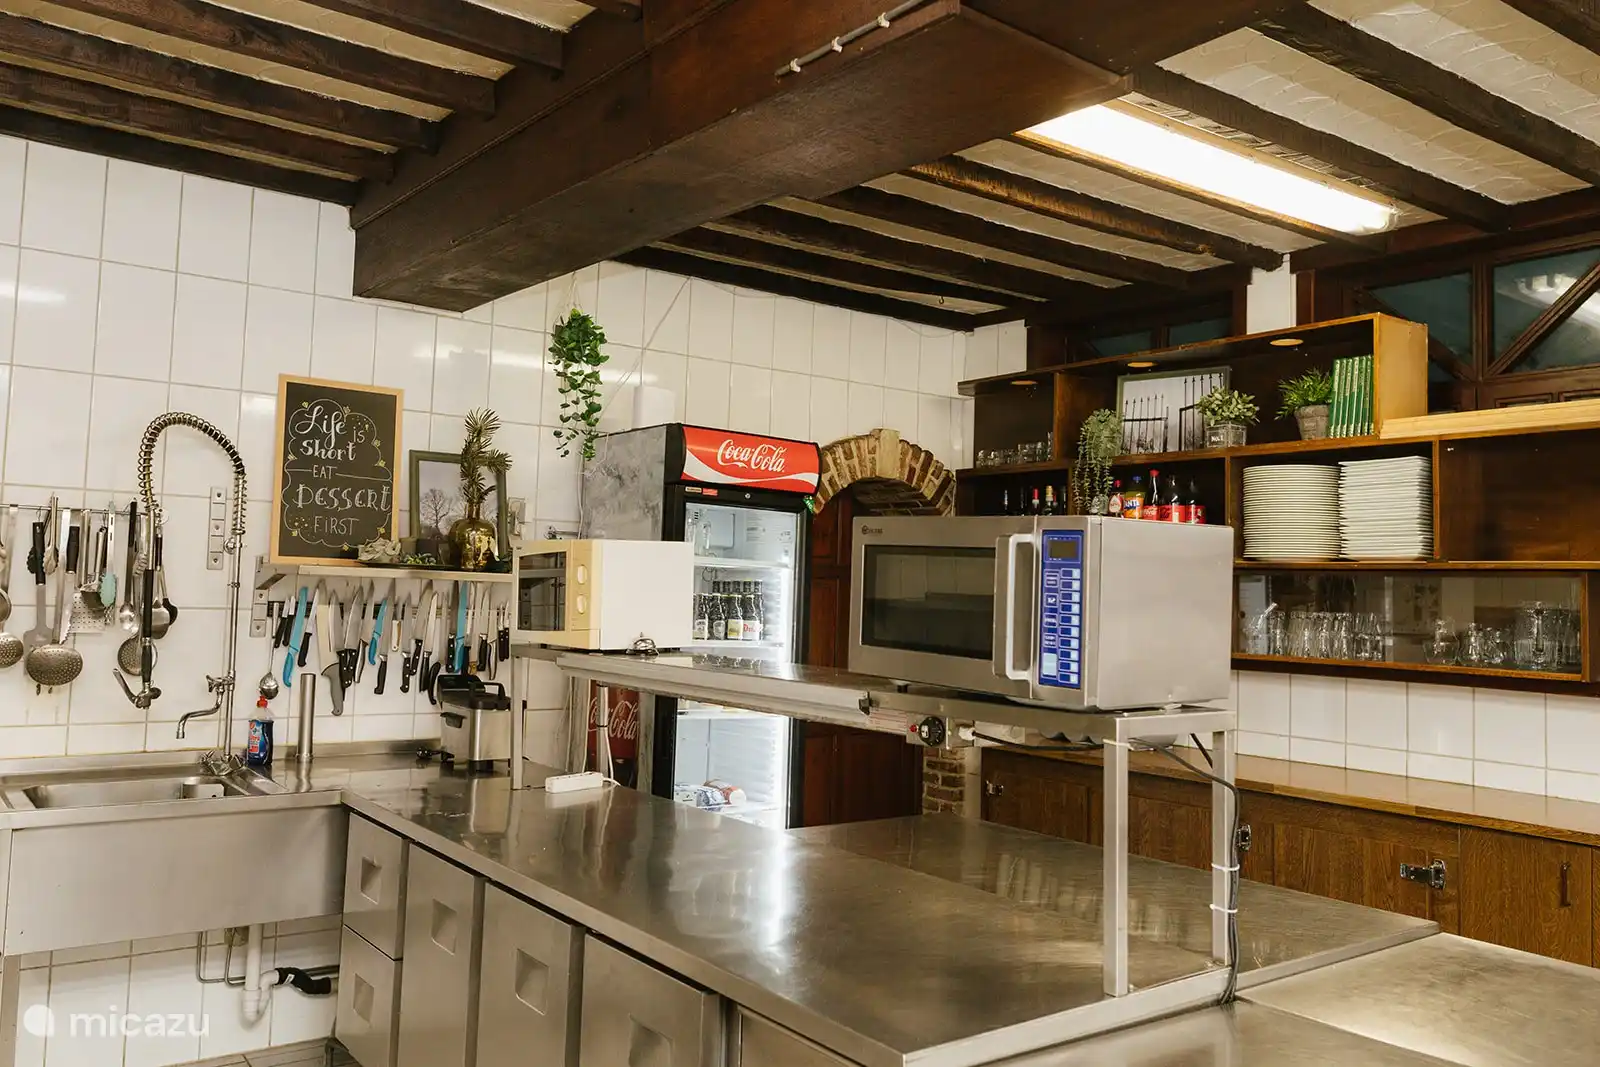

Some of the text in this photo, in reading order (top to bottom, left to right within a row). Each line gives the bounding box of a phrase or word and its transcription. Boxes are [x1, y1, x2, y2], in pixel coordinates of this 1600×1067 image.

[295, 405, 366, 449] Life is
[300, 438, 356, 461] Short
[717, 439, 787, 473] Coca-Cola
[312, 464, 337, 480] EAT
